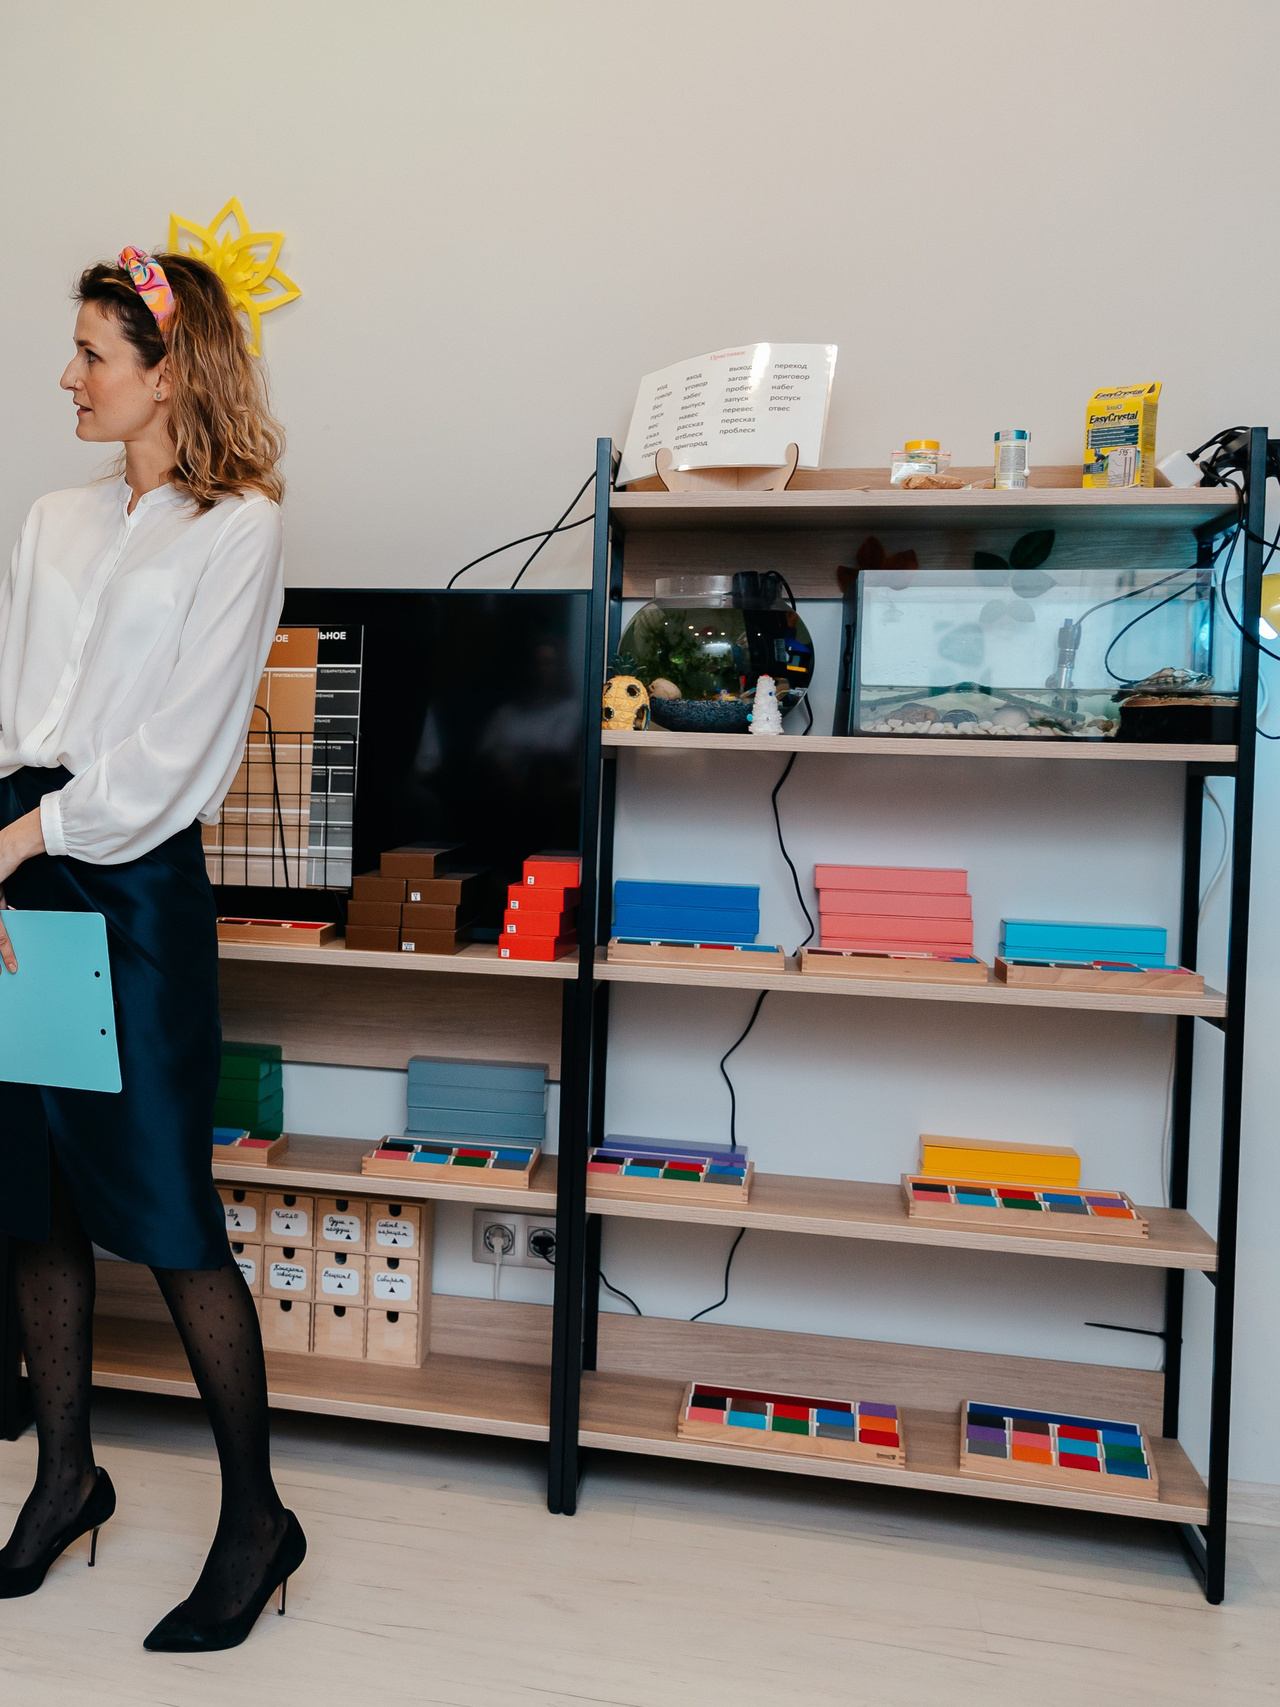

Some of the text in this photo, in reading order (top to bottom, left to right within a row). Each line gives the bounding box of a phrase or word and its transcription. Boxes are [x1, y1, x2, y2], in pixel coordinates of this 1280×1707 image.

[686, 373, 702, 382] вход
[684, 381, 708, 392] уговор
[654, 391, 672, 401] говор
[683, 392, 702, 400] забег
[1094, 388, 1146, 399] EasyCrystal
[724, 396, 749, 404] запуск
[680, 401, 706, 411] выпуск
[722, 406, 754, 414] перевес
[650, 412, 664, 420] пуск
[678, 412, 700, 420] навес
[720, 416, 756, 424] пересказ
[1090, 410, 1138, 424] EasyCrystal
[676, 421, 704, 432] рассказ
[719, 426, 756, 435] проблеск
[646, 432, 660, 440] сказ
[674, 431, 704, 441] отблеск
[644, 440, 662, 450] блеск
[673, 440, 708, 451] пригород
[642, 451, 657, 459] горо
[273, 634, 289, 642] ОЕ
[318, 632, 346, 640] ЬНОЕ
